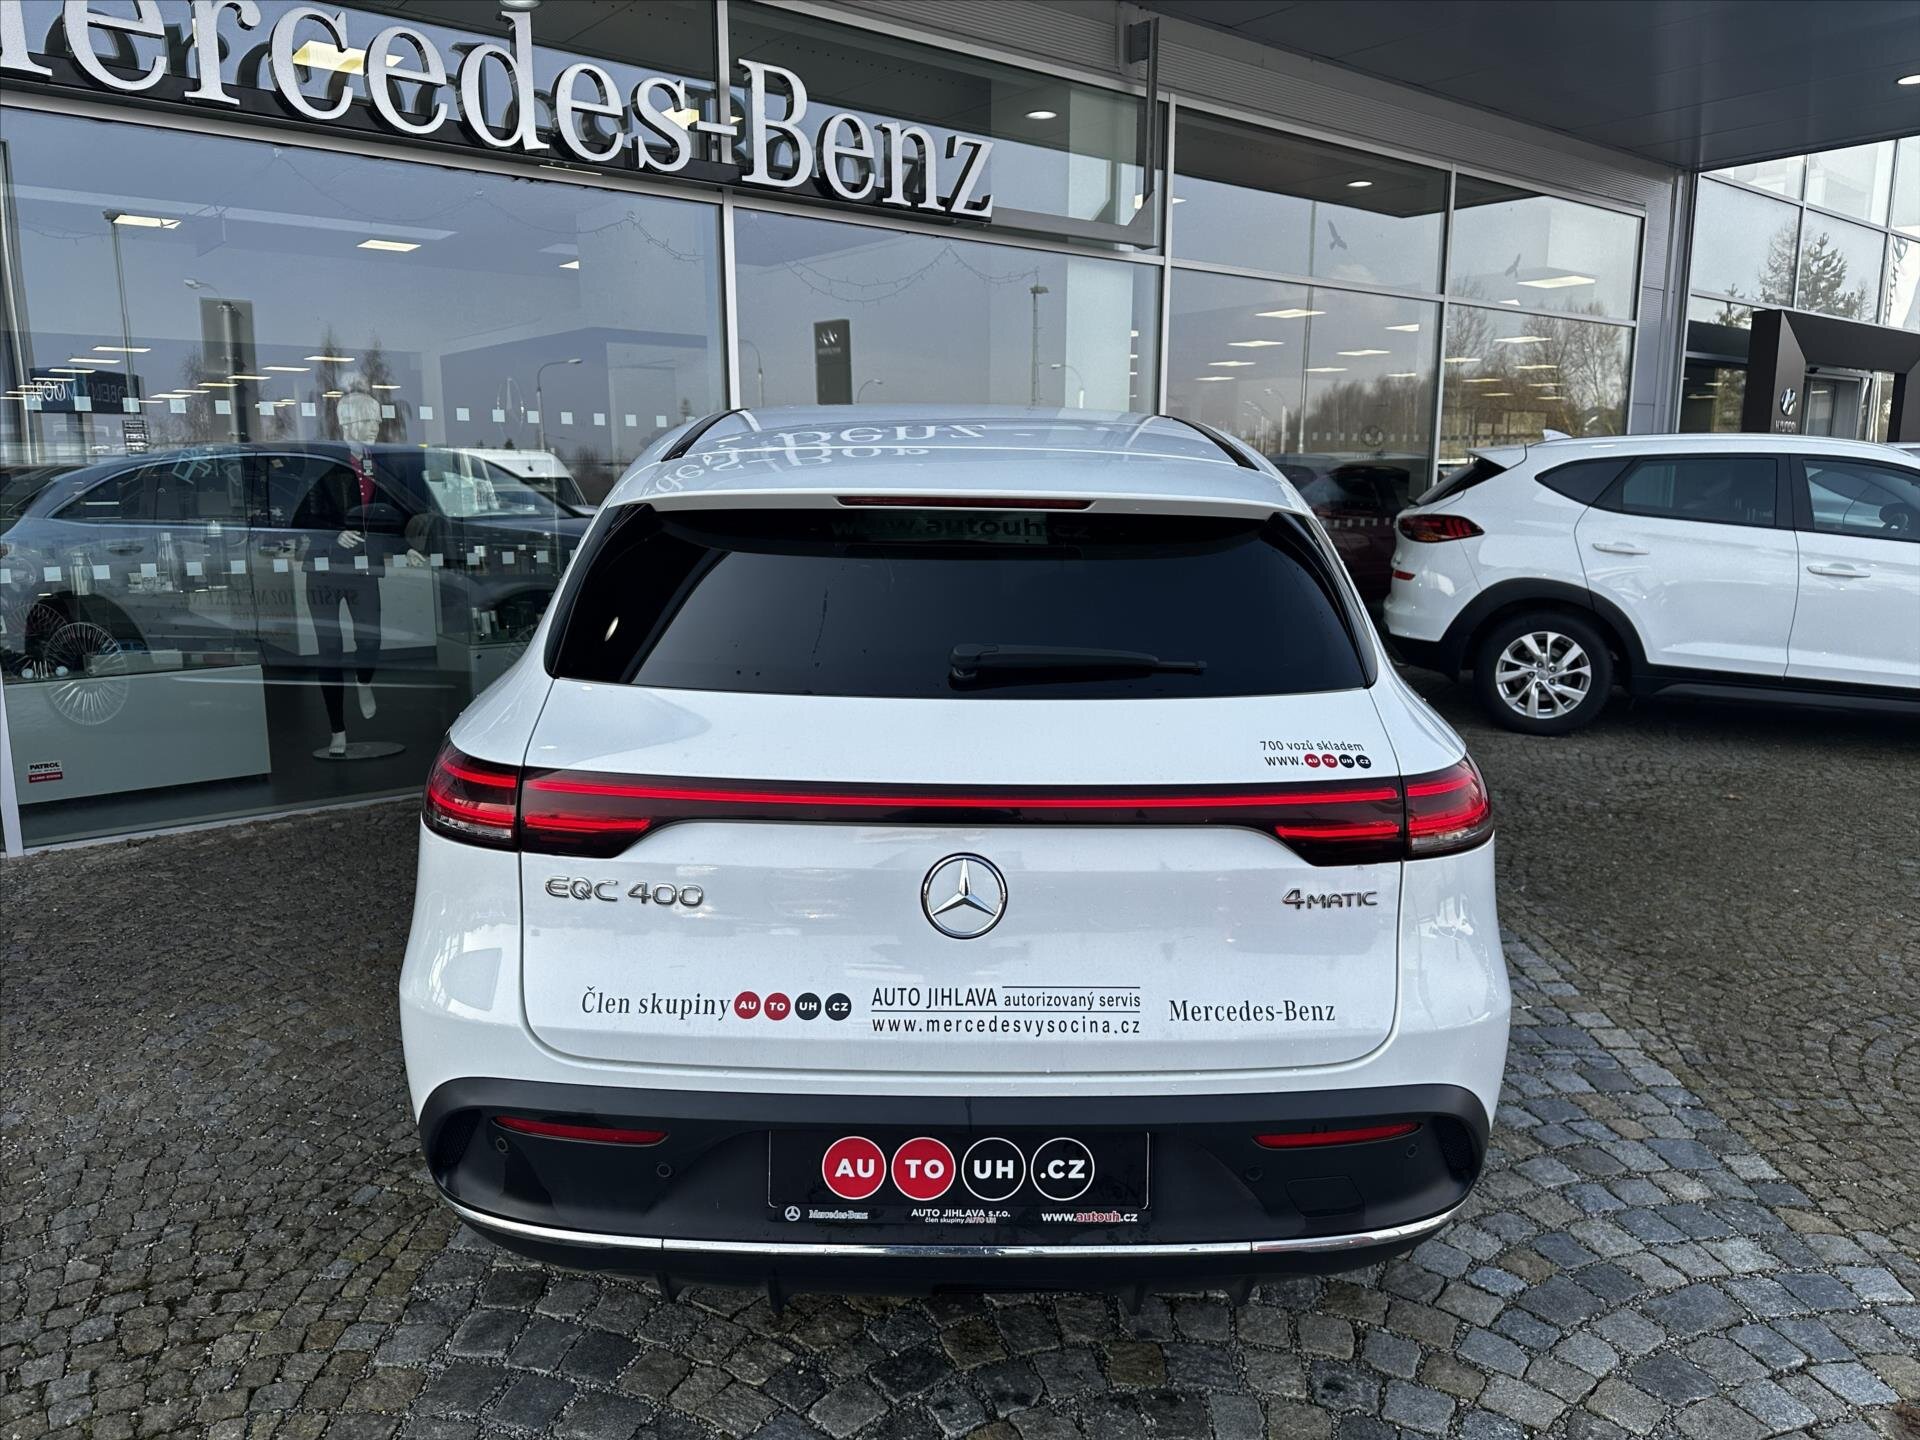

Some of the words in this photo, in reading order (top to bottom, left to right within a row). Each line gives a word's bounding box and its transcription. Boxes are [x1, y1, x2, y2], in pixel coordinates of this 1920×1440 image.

[1260, 740, 1284, 751] 700
[1286, 740, 1314, 751] vozů
[1316, 741, 1365, 751] skladem
[29, 762, 60, 770] PATROL
[545, 876, 618, 901] EQC
[627, 881, 704, 908] 400
[1282, 888, 1378, 909] 4MATIC
[581, 986, 631, 1014] Člen
[638, 992, 731, 1021] skupiny
[871, 987, 921, 1007] AUTO
[926, 987, 998, 1008] JIHLAVA
[1004, 991, 1095, 1011] autorizovaný
[1099, 992, 1141, 1007] servis
[1169, 1000, 1336, 1022] Mercedes-Benz
[872, 1016, 1141, 1037] www.mercedesvysocina.cz
[834, 1158, 876, 1179] AU
[905, 1159, 945, 1179] TO
[973, 1159, 1014, 1180] UH
[1039, 1159, 1086, 1180] .CZ
[911, 1208, 940, 1217] AUTO
[943, 1208, 985, 1218] JIHLAVA
[988, 1209, 1011, 1218] s.r.o.
[1042, 1210, 1138, 1223] www.autouh.cz
